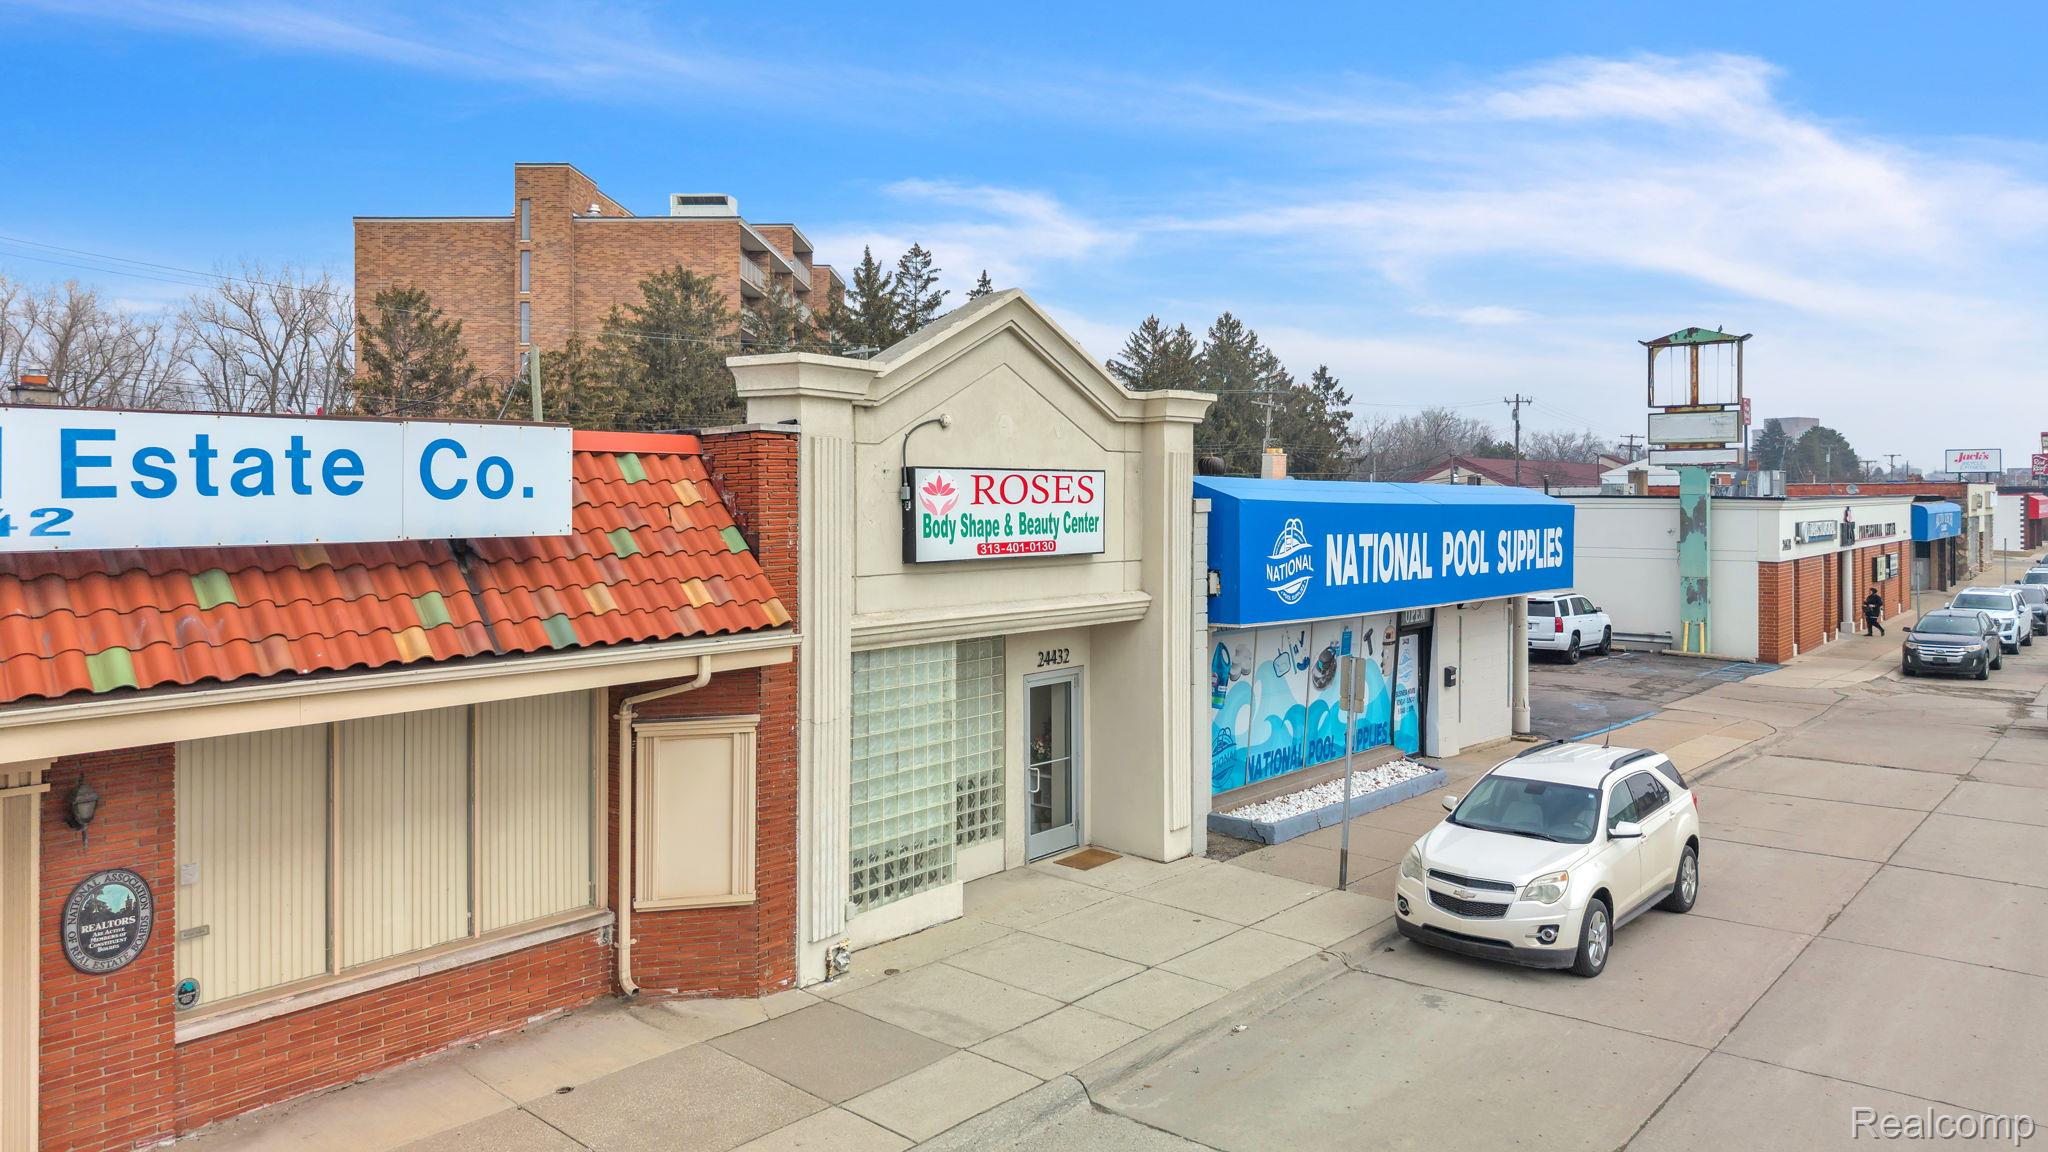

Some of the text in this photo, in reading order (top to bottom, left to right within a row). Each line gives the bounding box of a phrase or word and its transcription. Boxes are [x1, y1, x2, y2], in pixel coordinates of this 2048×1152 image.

[61, 428, 365, 499] Estate
[419, 438, 534, 500] Co.
[1954, 451, 1989, 463] Jack's
[970, 474, 1094, 505] ROSES
[922, 510, 1100, 544] Body Shape & Beauty Center
[980, 541, 1055, 554] 313-401-0130
[1325, 531, 1433, 587] NATIONAL
[1442, 529, 1489, 577] POOL
[1497, 526, 1563, 574] SUPPLIES
[1266, 554, 1314, 582] NATIONAL
[1037, 648, 1070, 667] 24432
[1248, 721, 1388, 781] NATIONAL POOL PPLIES
[68, 878, 101, 925] NATIONAL
[105, 873, 150, 911] ASSOCIATION
[81, 915, 136, 933] REALTORS
[68, 915, 150, 969] OF REAL ESTATE BOARDS
